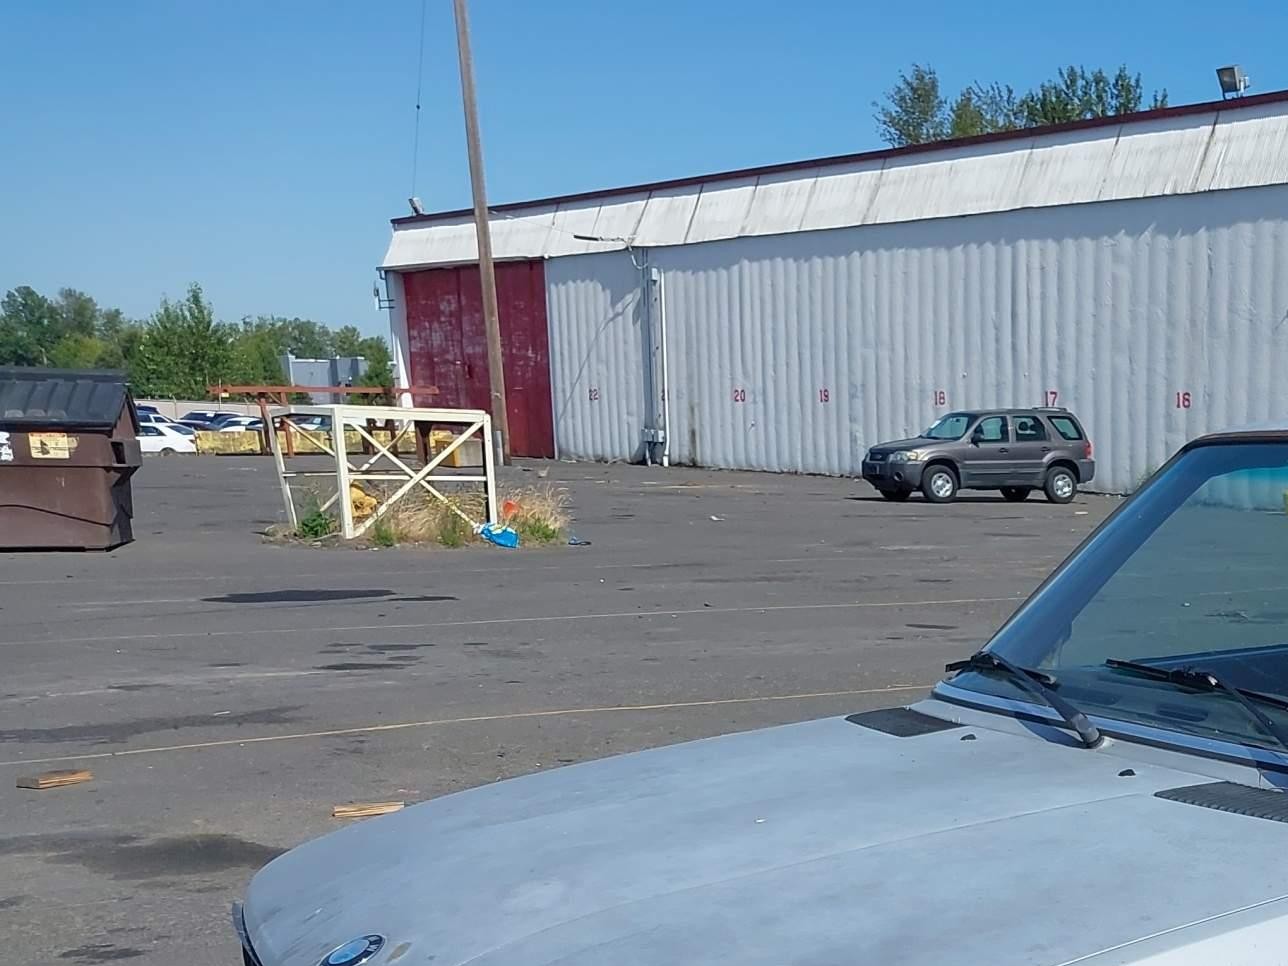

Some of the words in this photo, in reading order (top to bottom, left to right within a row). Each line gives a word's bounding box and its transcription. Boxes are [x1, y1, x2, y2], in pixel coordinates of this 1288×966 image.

[734, 389, 746, 402] 20
[819, 389, 829, 402] 19
[934, 391, 946, 405] 18
[1045, 391, 1058, 407] 17
[1176, 392, 1191, 408] 16
